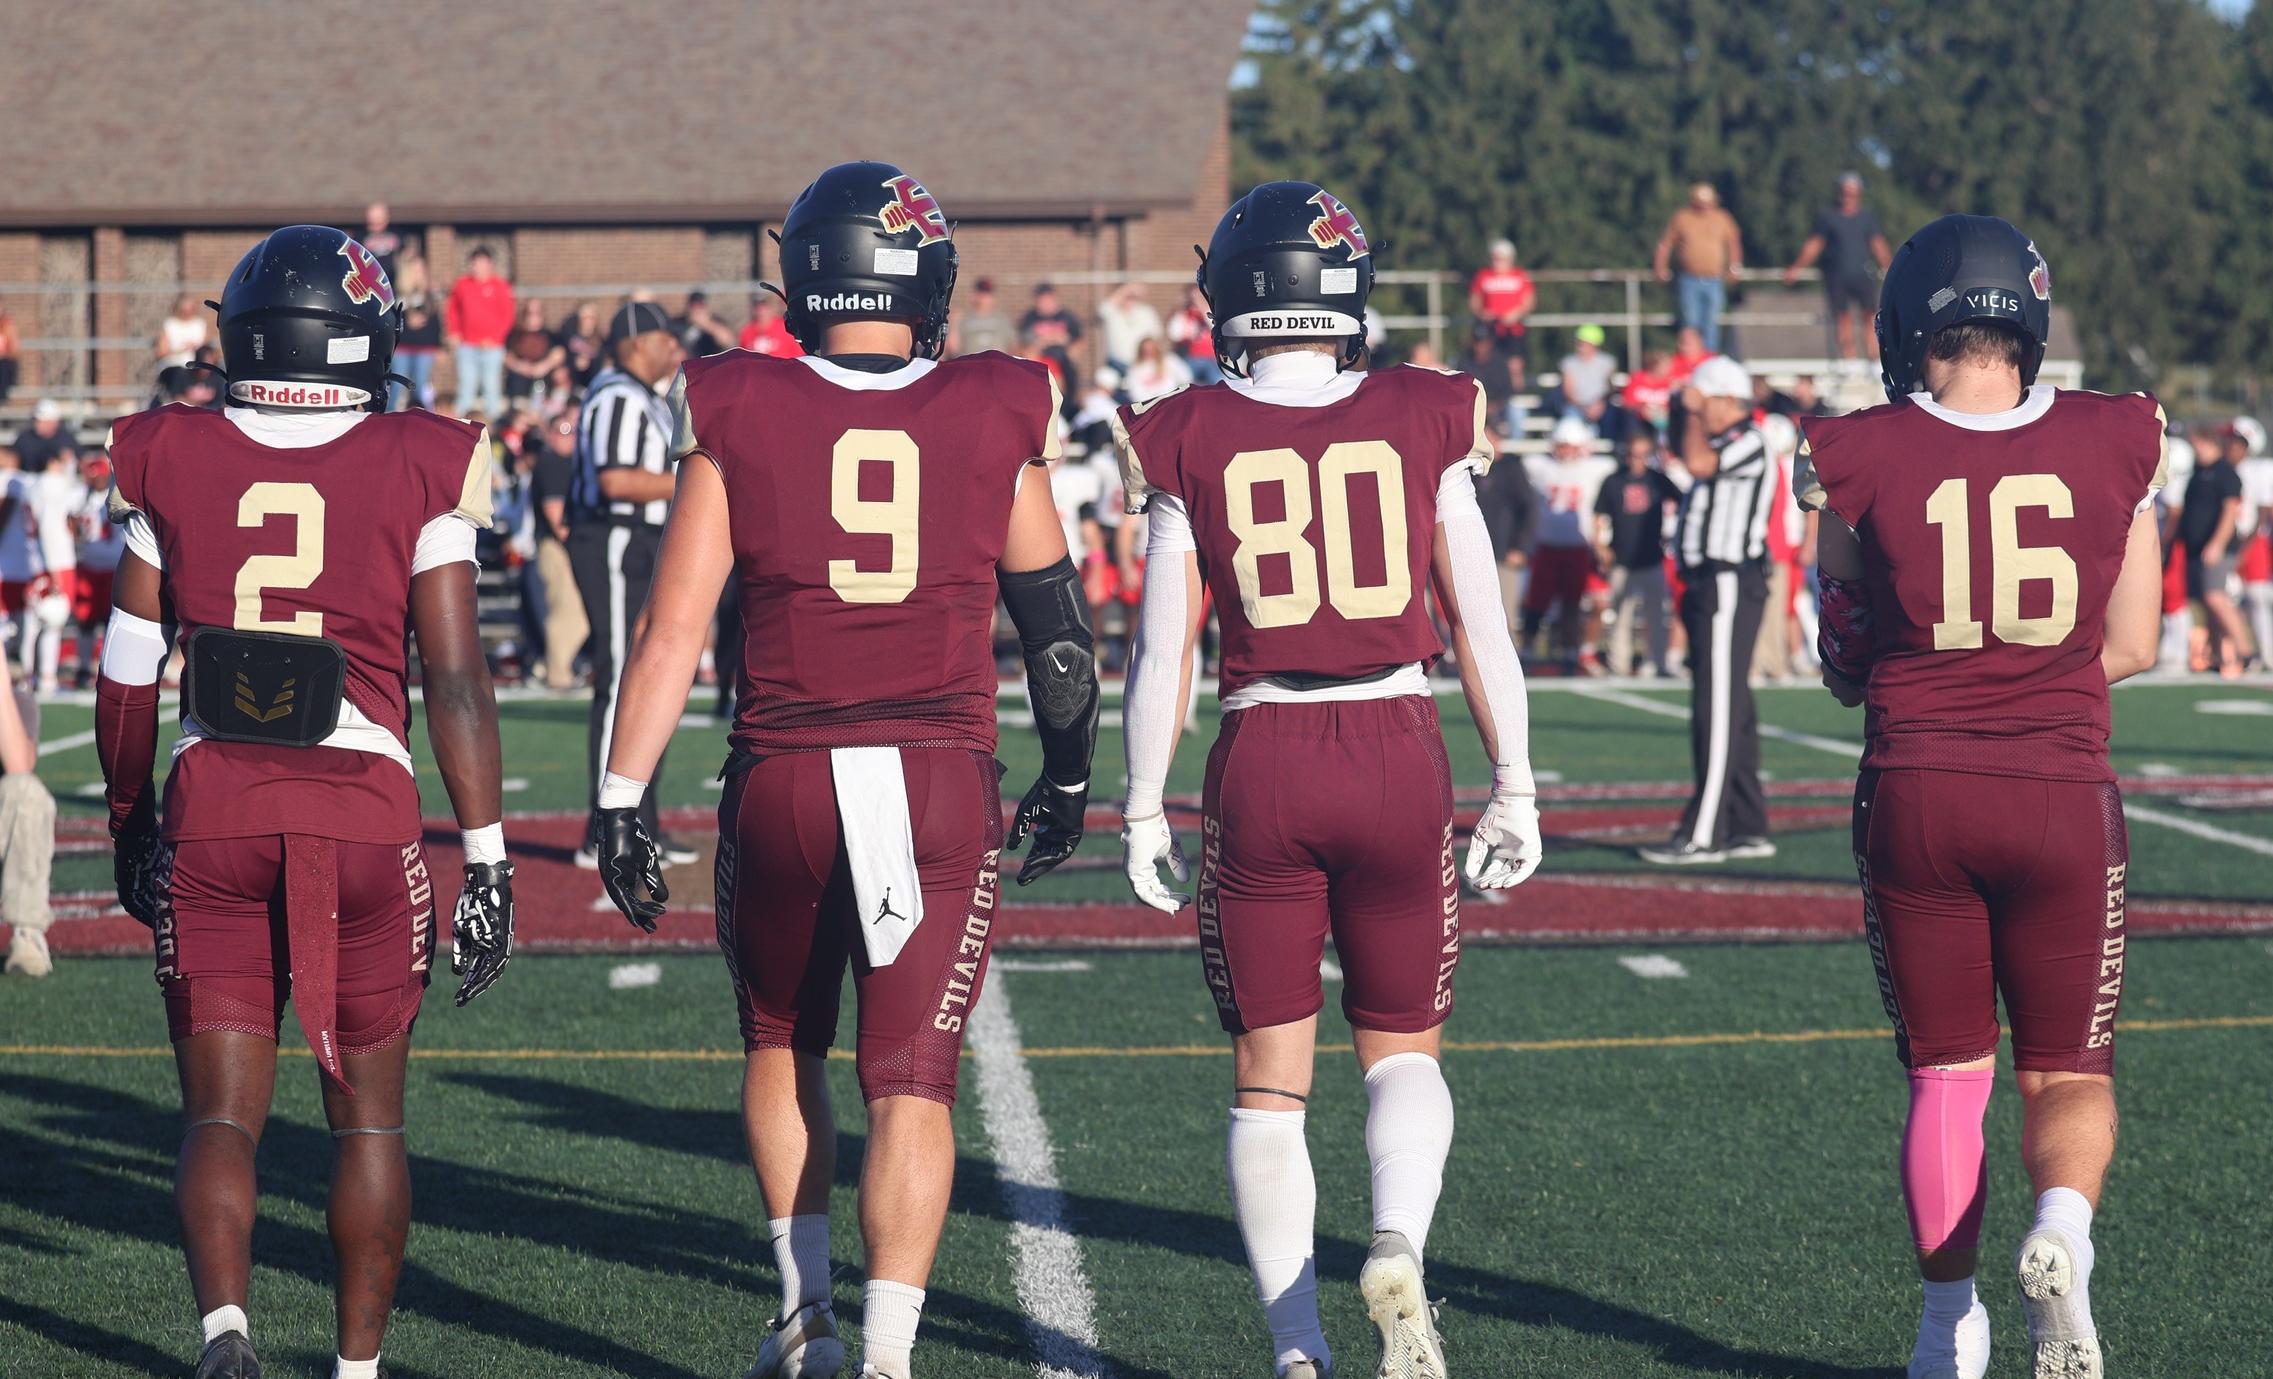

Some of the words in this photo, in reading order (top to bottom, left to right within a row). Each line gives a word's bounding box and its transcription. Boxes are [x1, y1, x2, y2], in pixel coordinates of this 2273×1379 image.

[806, 293, 892, 312] Riddell
[1250, 317, 1283, 330] RED
[1286, 317, 1335, 329] DEVIL
[1966, 294, 2019, 312] VICIS
[250, 384, 340, 406] Riddell
[828, 428, 920, 604] 9
[1223, 439, 1412, 629] 80
[233, 481, 326, 638] 2
[1926, 473, 2079, 651] 16
[401, 840, 432, 906] RED
[972, 847, 1002, 910] RED
[1200, 815, 1221, 939] DEVILS
[1441, 816, 1456, 888] RED
[2106, 861, 2127, 929] RED
[933, 914, 990, 1033] DEVILS
[1204, 946, 1236, 1012] RED
[1434, 889, 1459, 1013] DEVILS
[2086, 934, 2126, 1049] DEVILS
